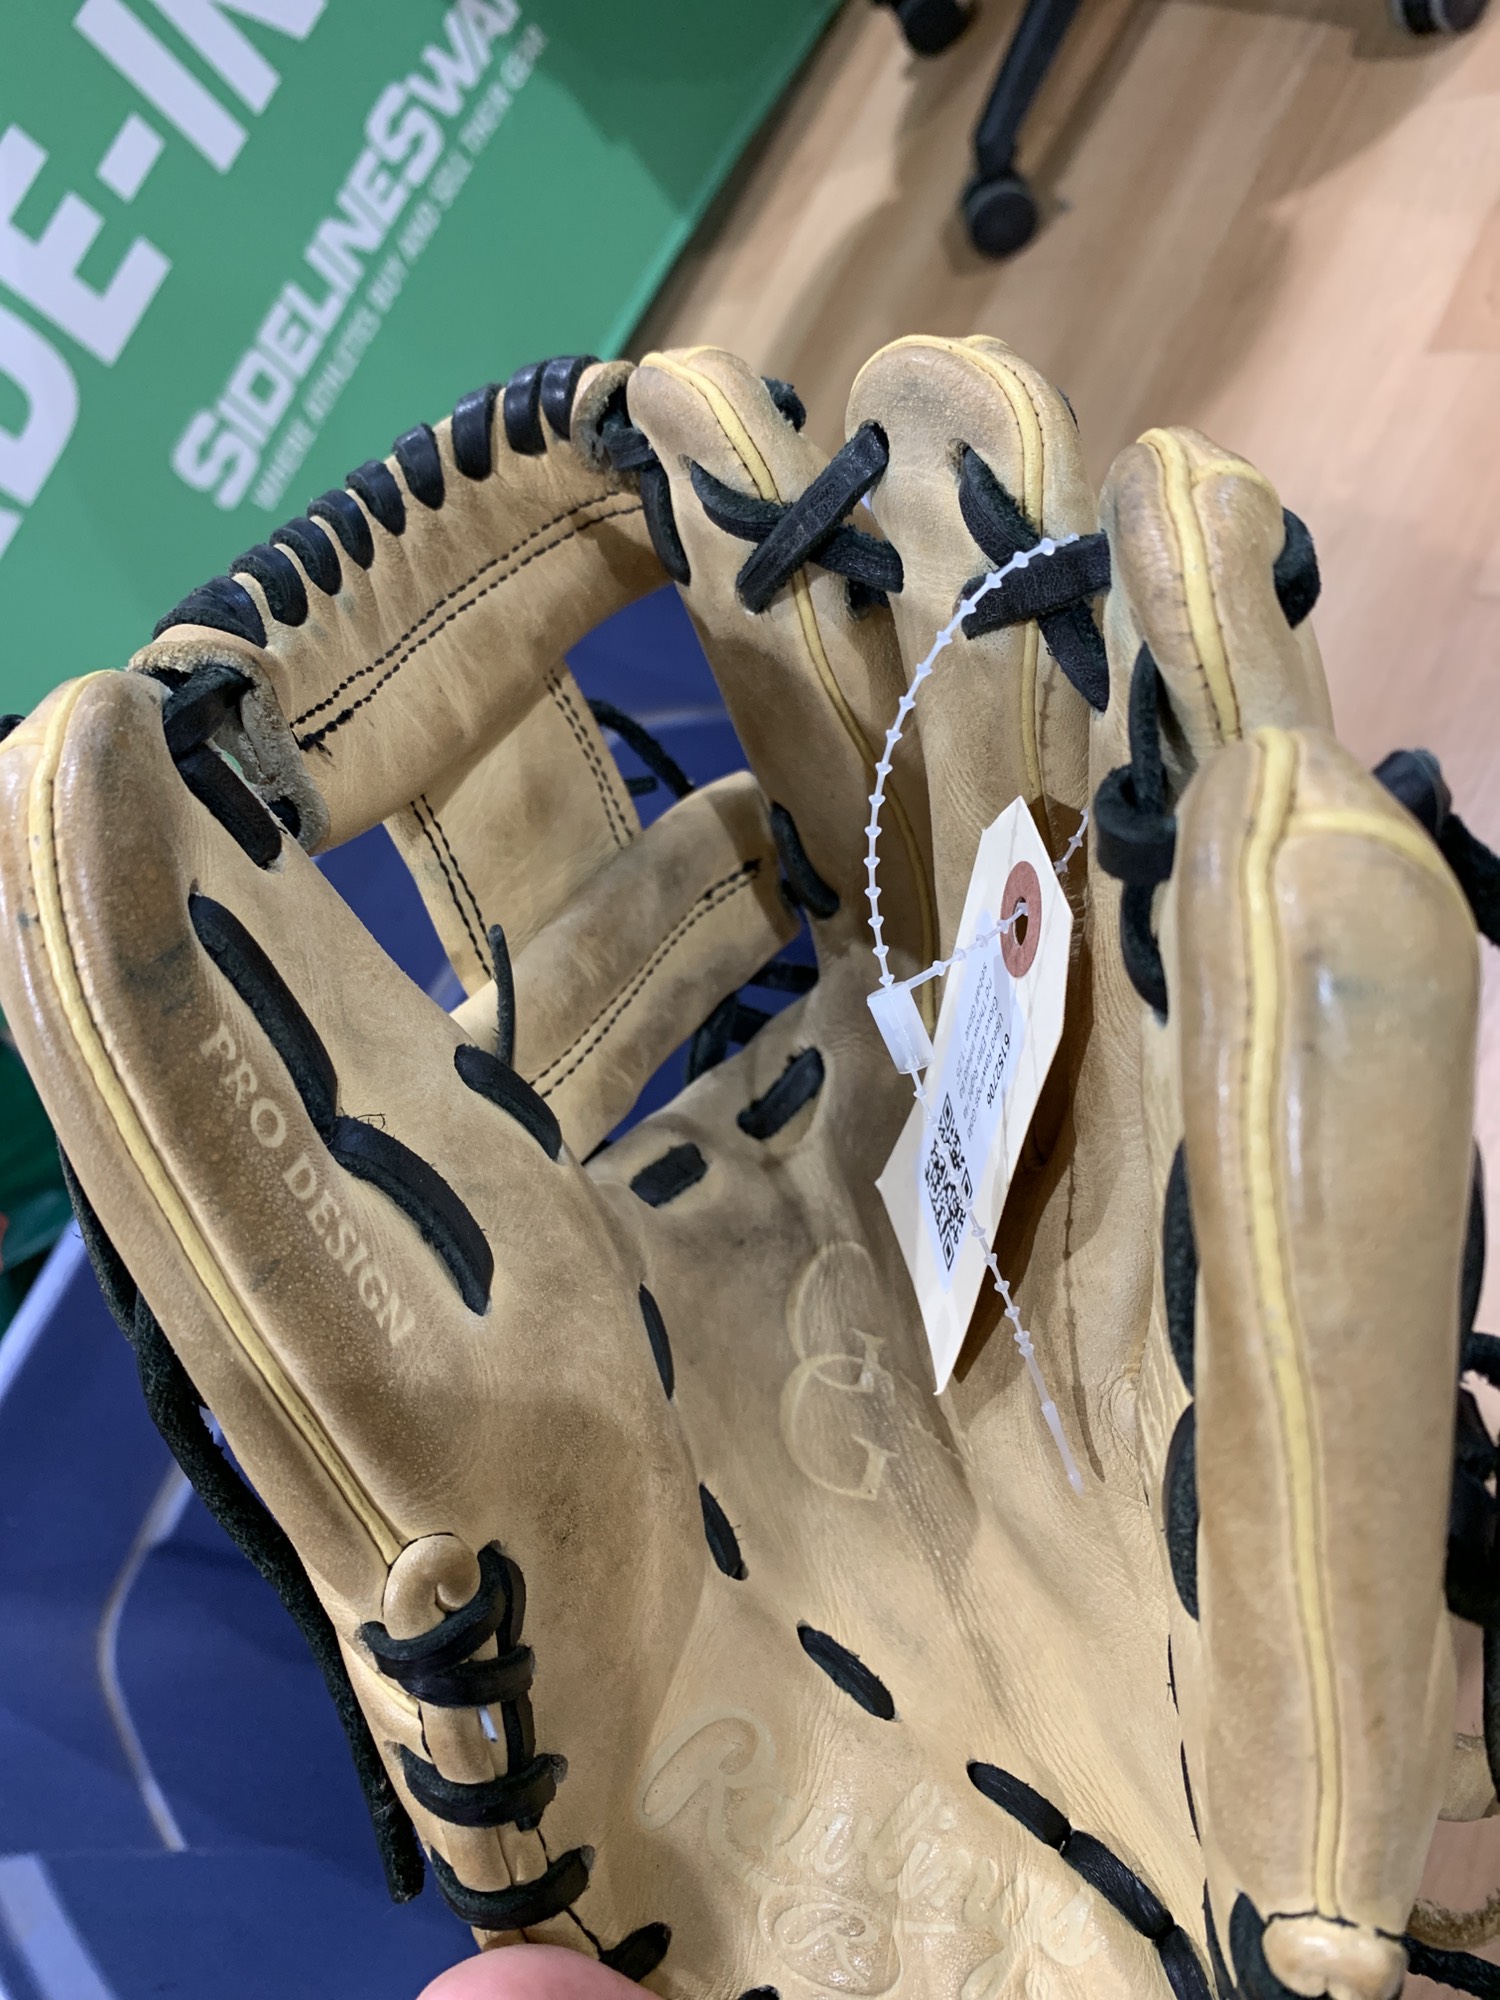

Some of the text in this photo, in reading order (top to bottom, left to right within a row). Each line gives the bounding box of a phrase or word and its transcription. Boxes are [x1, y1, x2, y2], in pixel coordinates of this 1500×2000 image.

[170, 0, 521, 512] SIDELINESWA
[965, 1004, 976, 1044] Glove
[974, 999, 986, 1044] Throw
[985, 993, 998, 1040] Glove
[991, 1010, 1003, 1055] Used
[977, 1035, 986, 1069] Elite
[987, 1034, 1010, 1109] 6152706
[974, 1047, 992, 1111] Rawlings
[200, 1021, 416, 1347] PRO DESIGN
